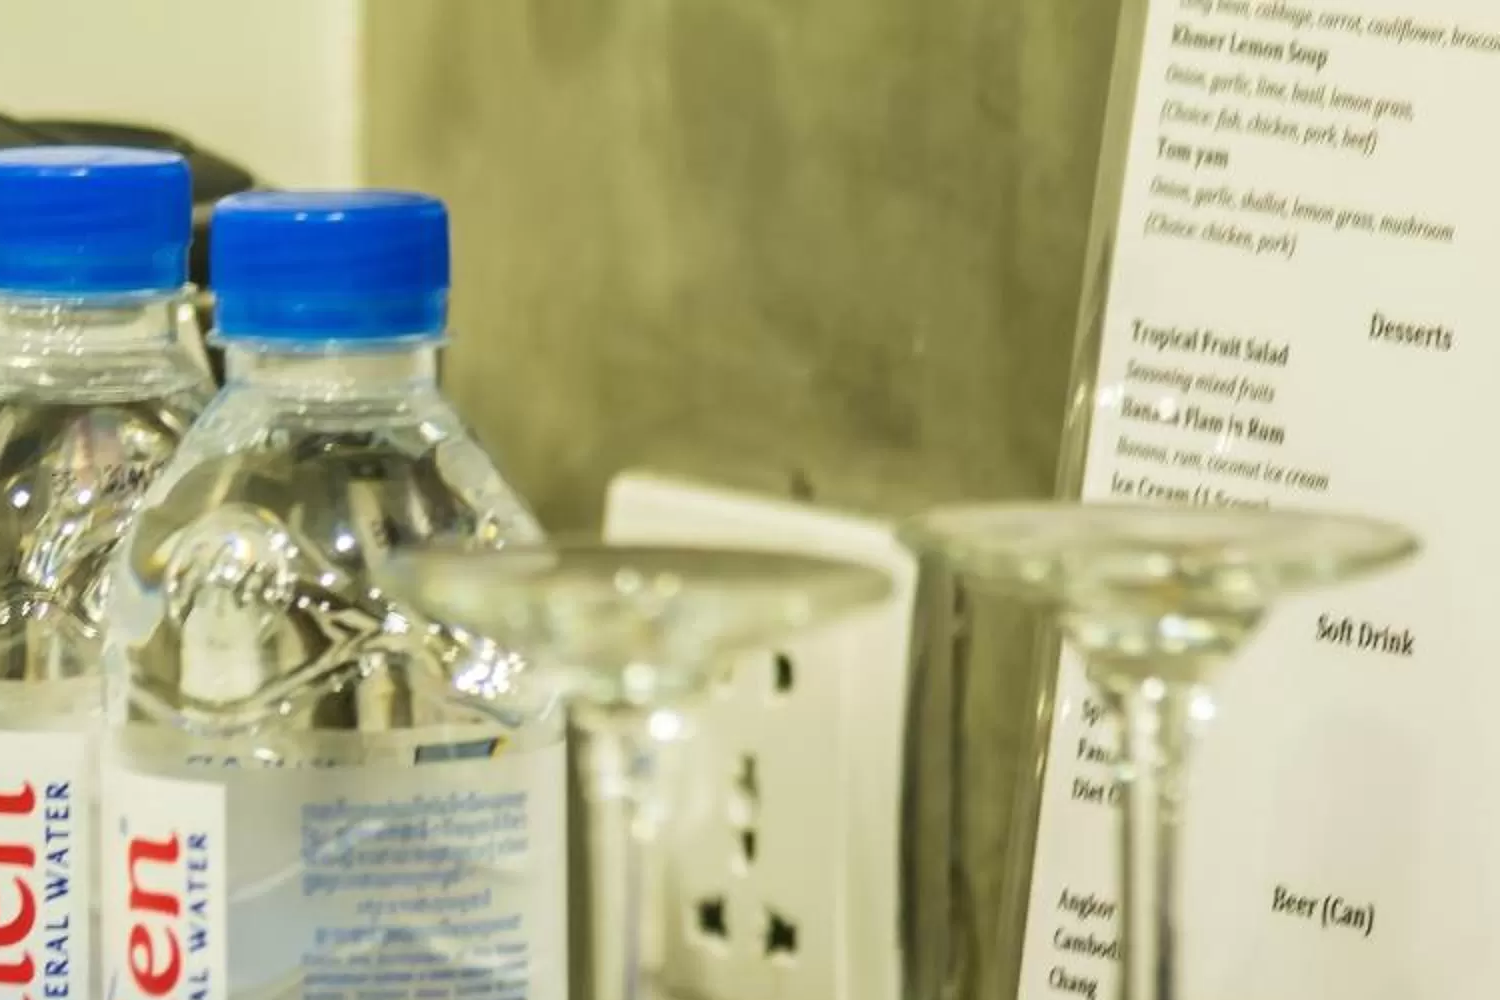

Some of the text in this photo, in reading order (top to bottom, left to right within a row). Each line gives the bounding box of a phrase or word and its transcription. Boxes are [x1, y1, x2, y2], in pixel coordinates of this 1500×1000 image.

[1171, 22, 1328, 72] Khmer Lemon Soup
[1156, 135, 1229, 170] Tom yam
[1131, 317, 1291, 368] Tropical Fruit Salad
[1368, 309, 1453, 352] Desserts
[1120, 395, 1180, 428] Banaa
[1248, 416, 1286, 446] Rum
[1110, 470, 1134, 494] Ice
[1137, 474, 1190, 502] Cream
[1314, 611, 1415, 657] Soft Drink
[1071, 778, 1104, 804] Diet
[43, 780, 71, 903] WATER
[186, 832, 209, 952] WATER
[1056, 886, 1116, 921] Angkor
[1270, 883, 1376, 937] Beer (Can)
[1053, 926, 1122, 961] Cambod
